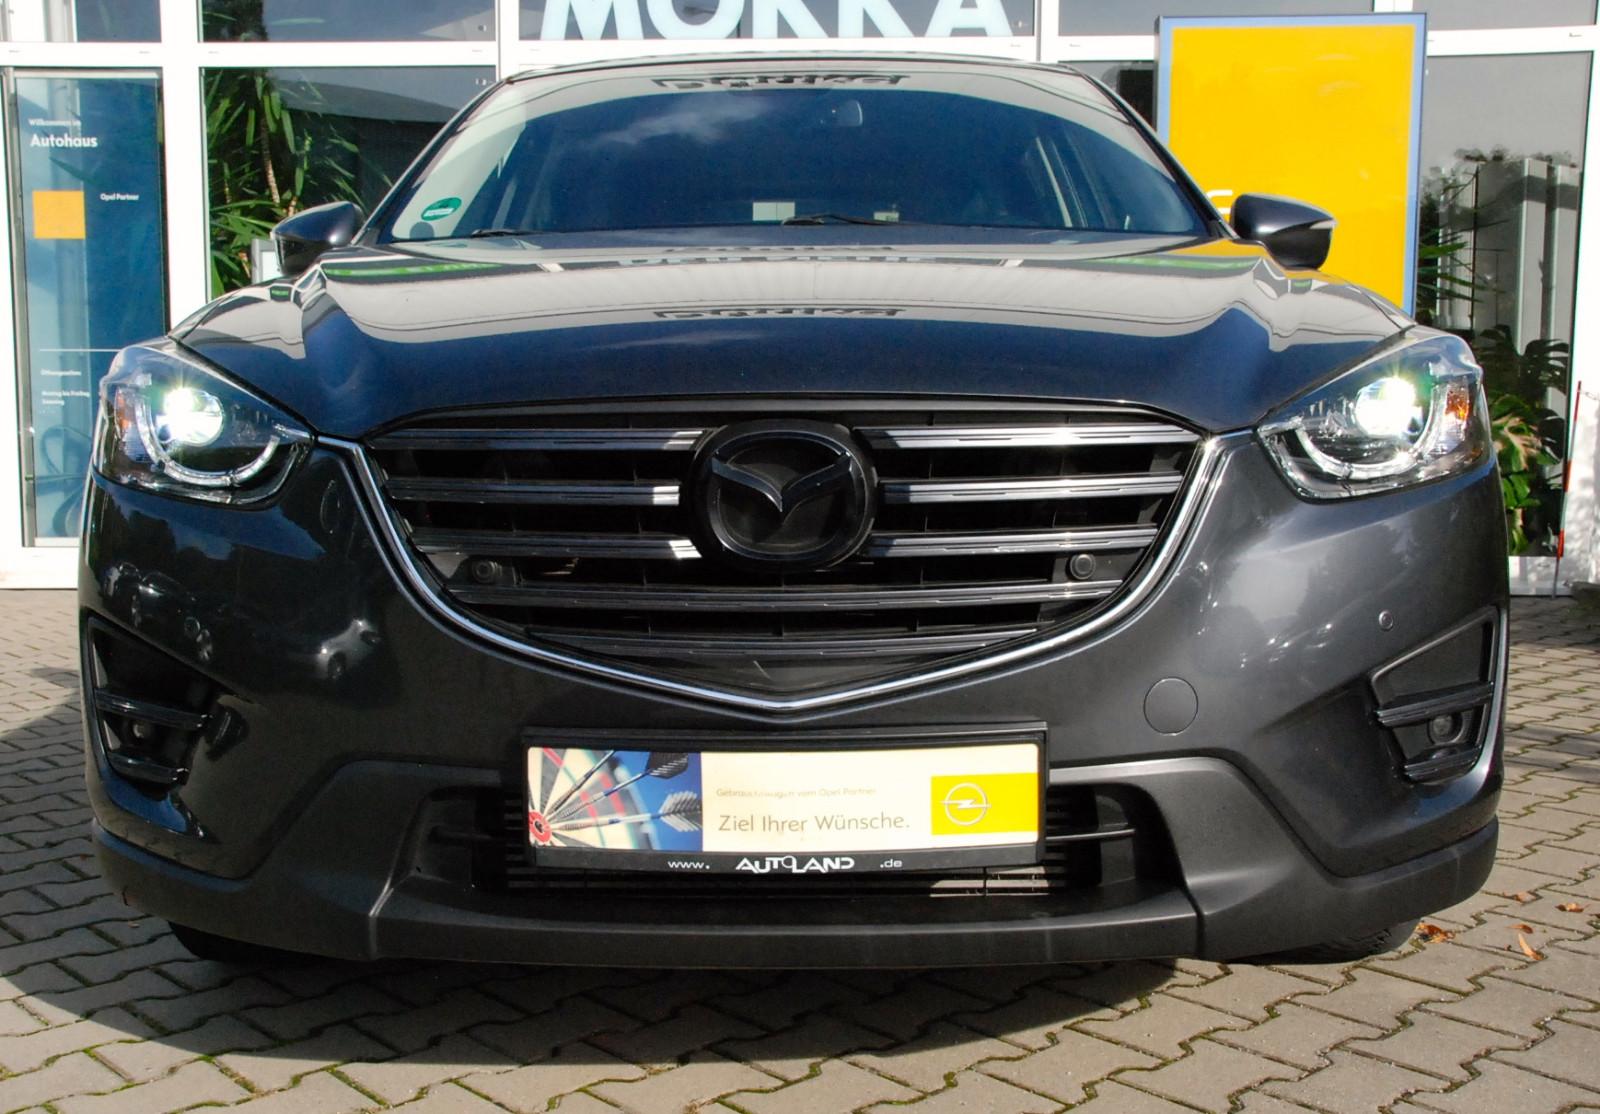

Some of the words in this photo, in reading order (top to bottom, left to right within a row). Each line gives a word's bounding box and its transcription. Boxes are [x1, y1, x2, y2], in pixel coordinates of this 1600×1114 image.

[30, 133, 98, 148] Autohaus
[718, 814, 754, 832] Ziel
[762, 814, 808, 832] Ihrer
[814, 811, 910, 831] Wünsche.
[668, 861, 710, 870] www.
[735, 855, 855, 874] AUTOLAND
[880, 858, 903, 868] .de
